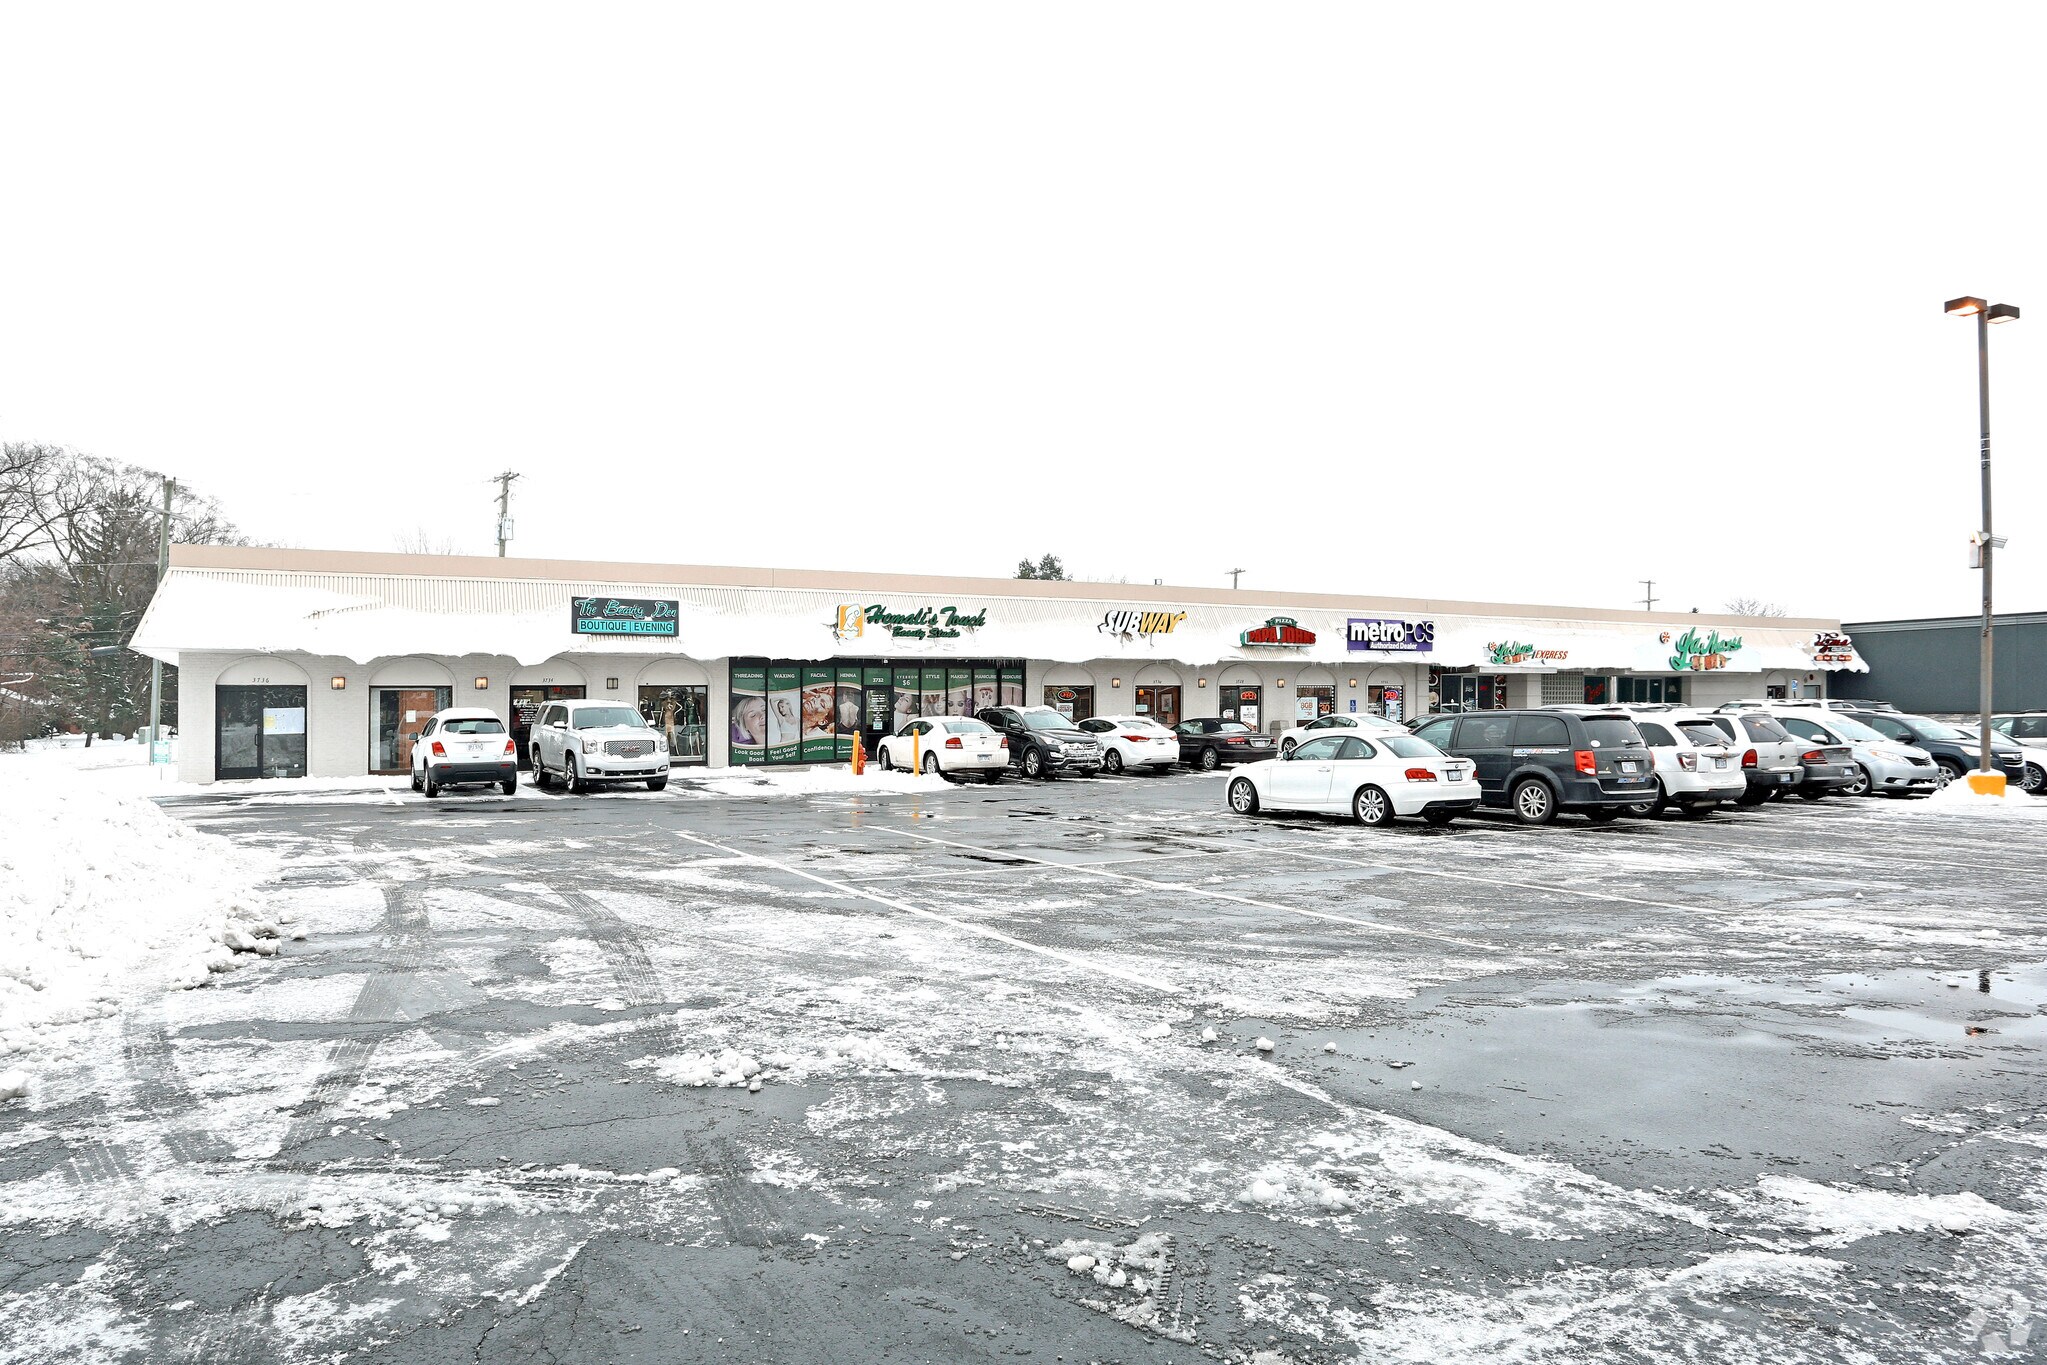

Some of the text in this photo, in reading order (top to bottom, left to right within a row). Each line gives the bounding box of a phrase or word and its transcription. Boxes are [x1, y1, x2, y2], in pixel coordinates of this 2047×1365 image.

[574, 598, 677, 619] The Beauty Den
[865, 604, 987, 627] Hemali's Touch
[580, 620, 673, 632] BOUTIQUE EVENING
[1097, 610, 1187, 633] SUBWAY
[892, 626, 961, 640] Beauty Studio
[1248, 626, 1278, 643] PAPA
[1350, 620, 1435, 643] metroPCS
[1535, 650, 1569, 660] EXPRESS
[734, 748, 748, 756] Look
[783, 745, 797, 753] Good
[803, 745, 834, 753] Confidence
